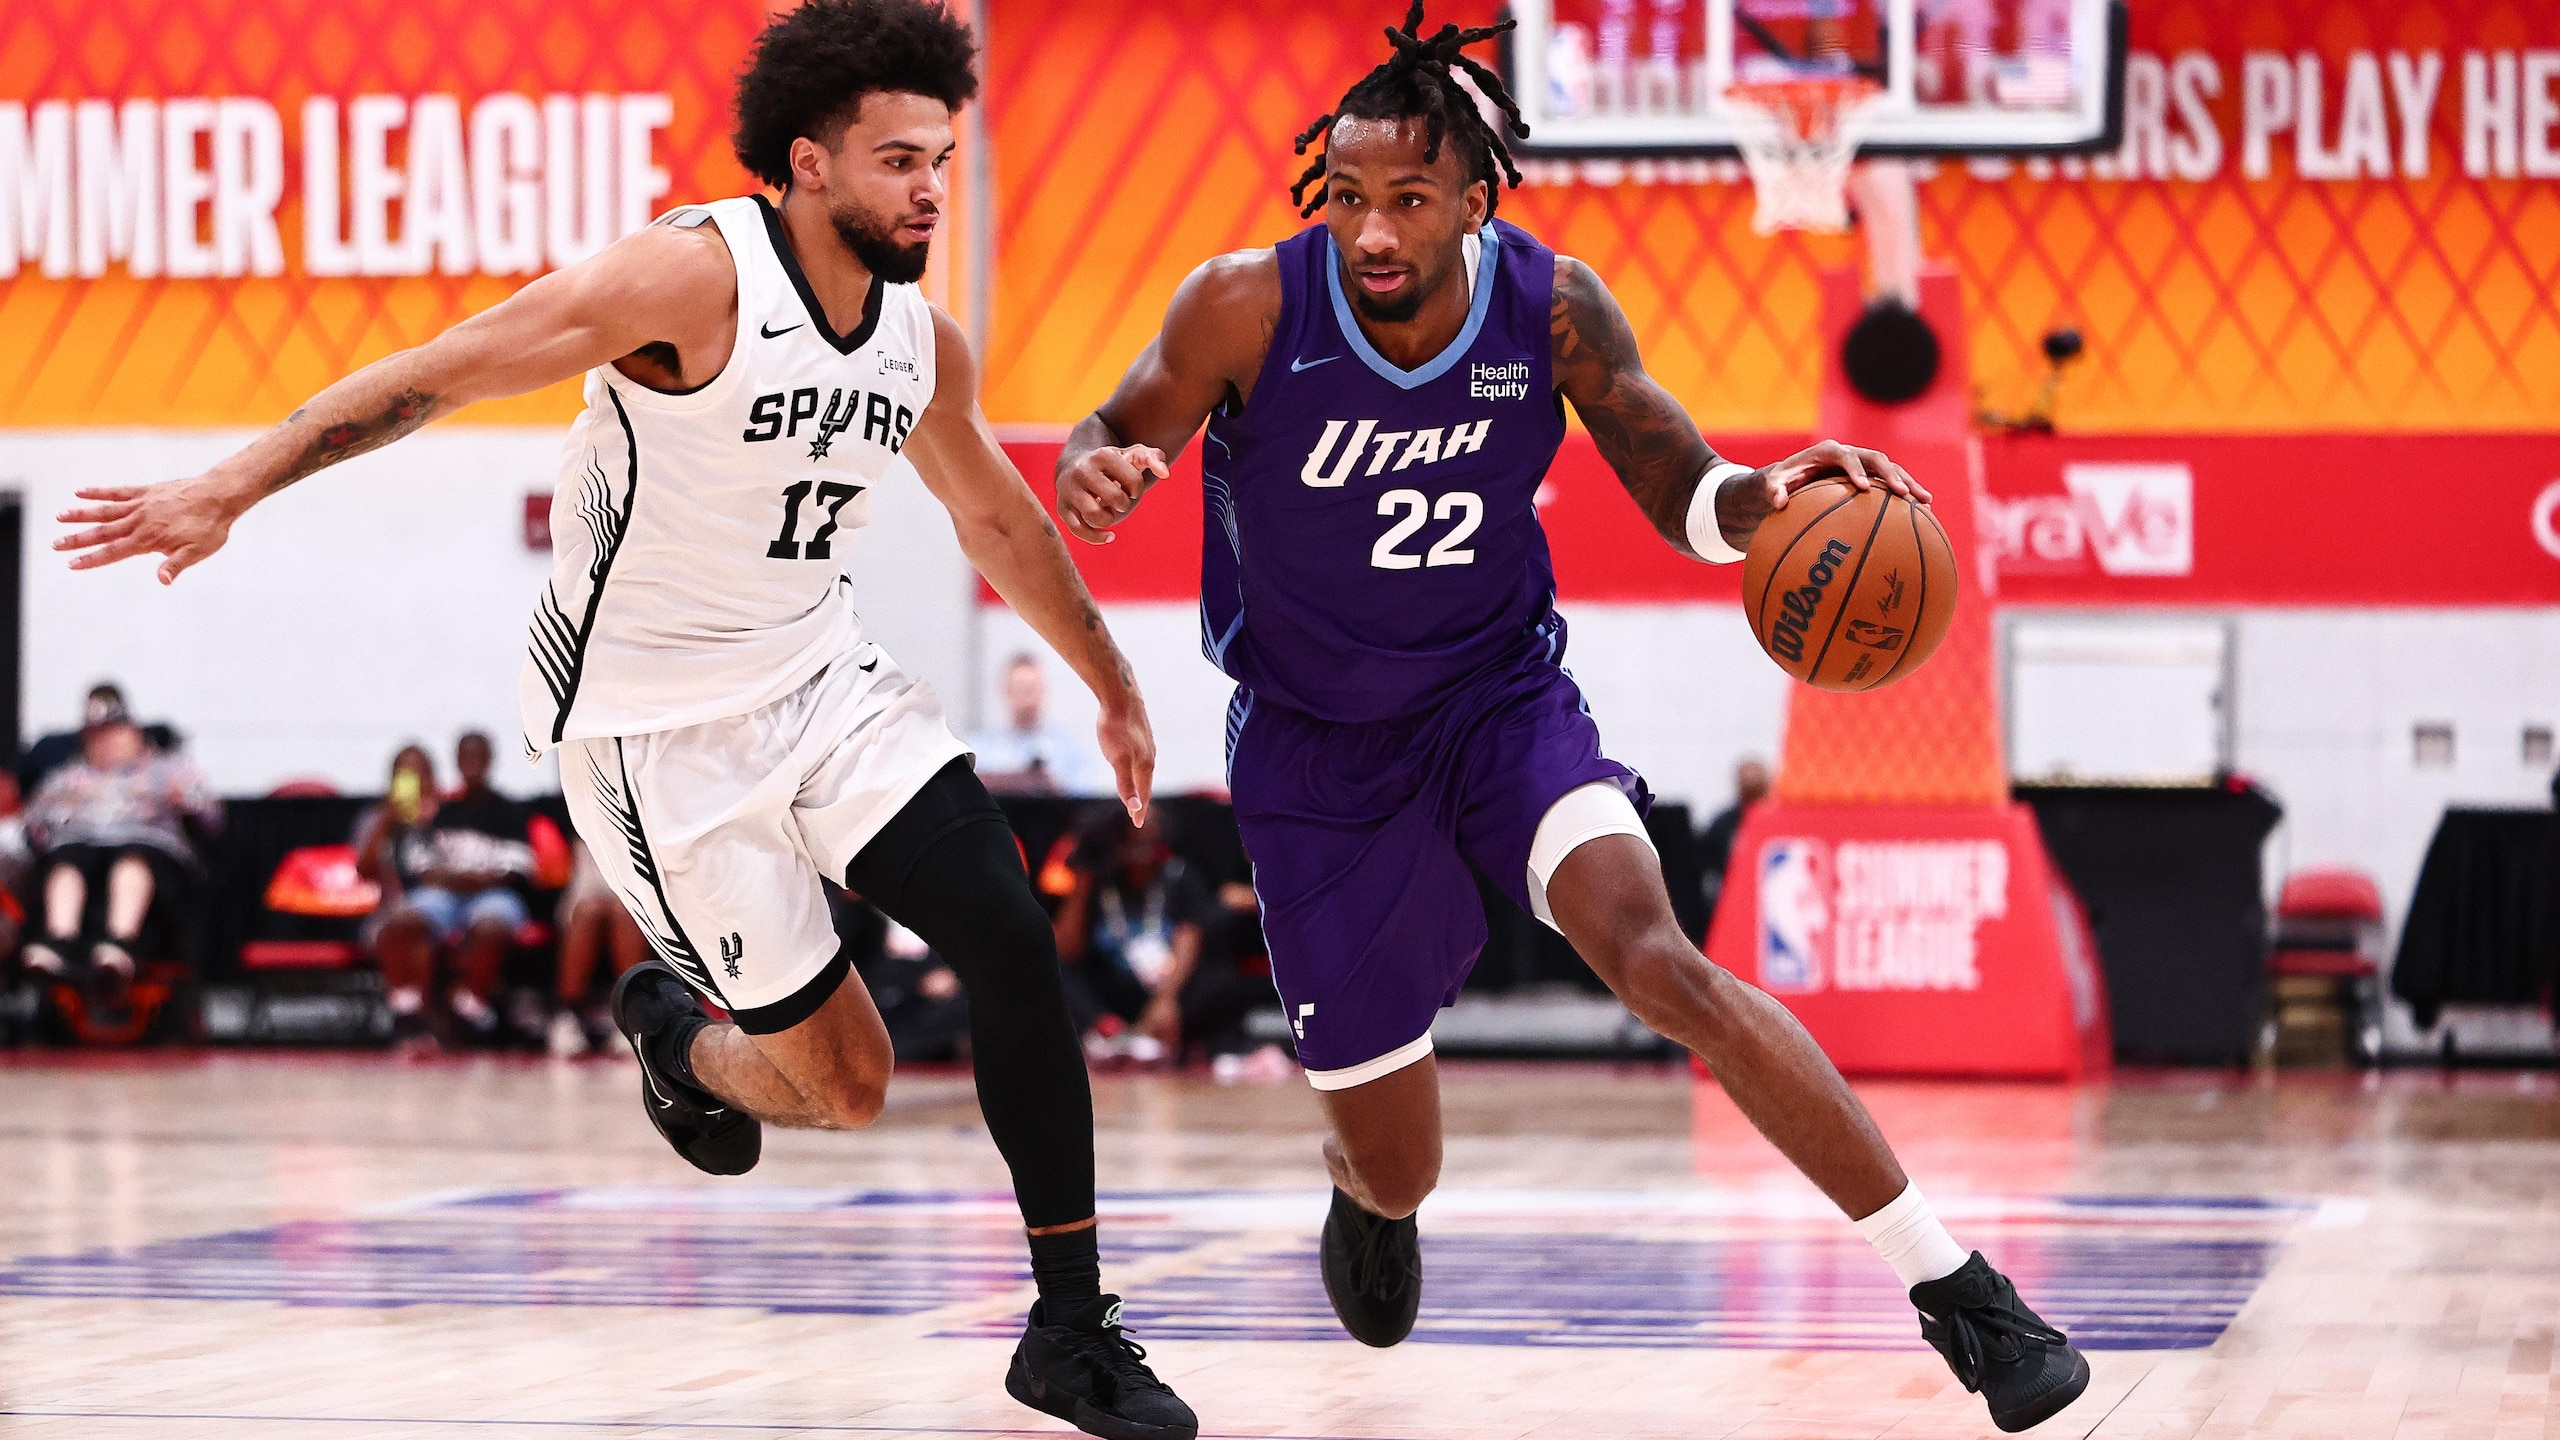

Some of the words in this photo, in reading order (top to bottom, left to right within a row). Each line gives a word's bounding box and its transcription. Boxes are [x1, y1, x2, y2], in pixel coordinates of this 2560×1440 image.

[2241, 49, 2444, 181] PLAY
[303, 93, 674, 276] LEAGUE
[884, 358, 914, 374] LEDGER
[1470, 361, 1529, 380] Health
[1470, 380, 1529, 402] Equity
[743, 387, 913, 463] SPURS
[766, 480, 867, 560] 17
[1370, 488, 1485, 570] 22
[1771, 537, 1853, 663] Wilson
[1836, 838, 2010, 920] SUMMER
[1836, 917, 1981, 992] LEAGUE
